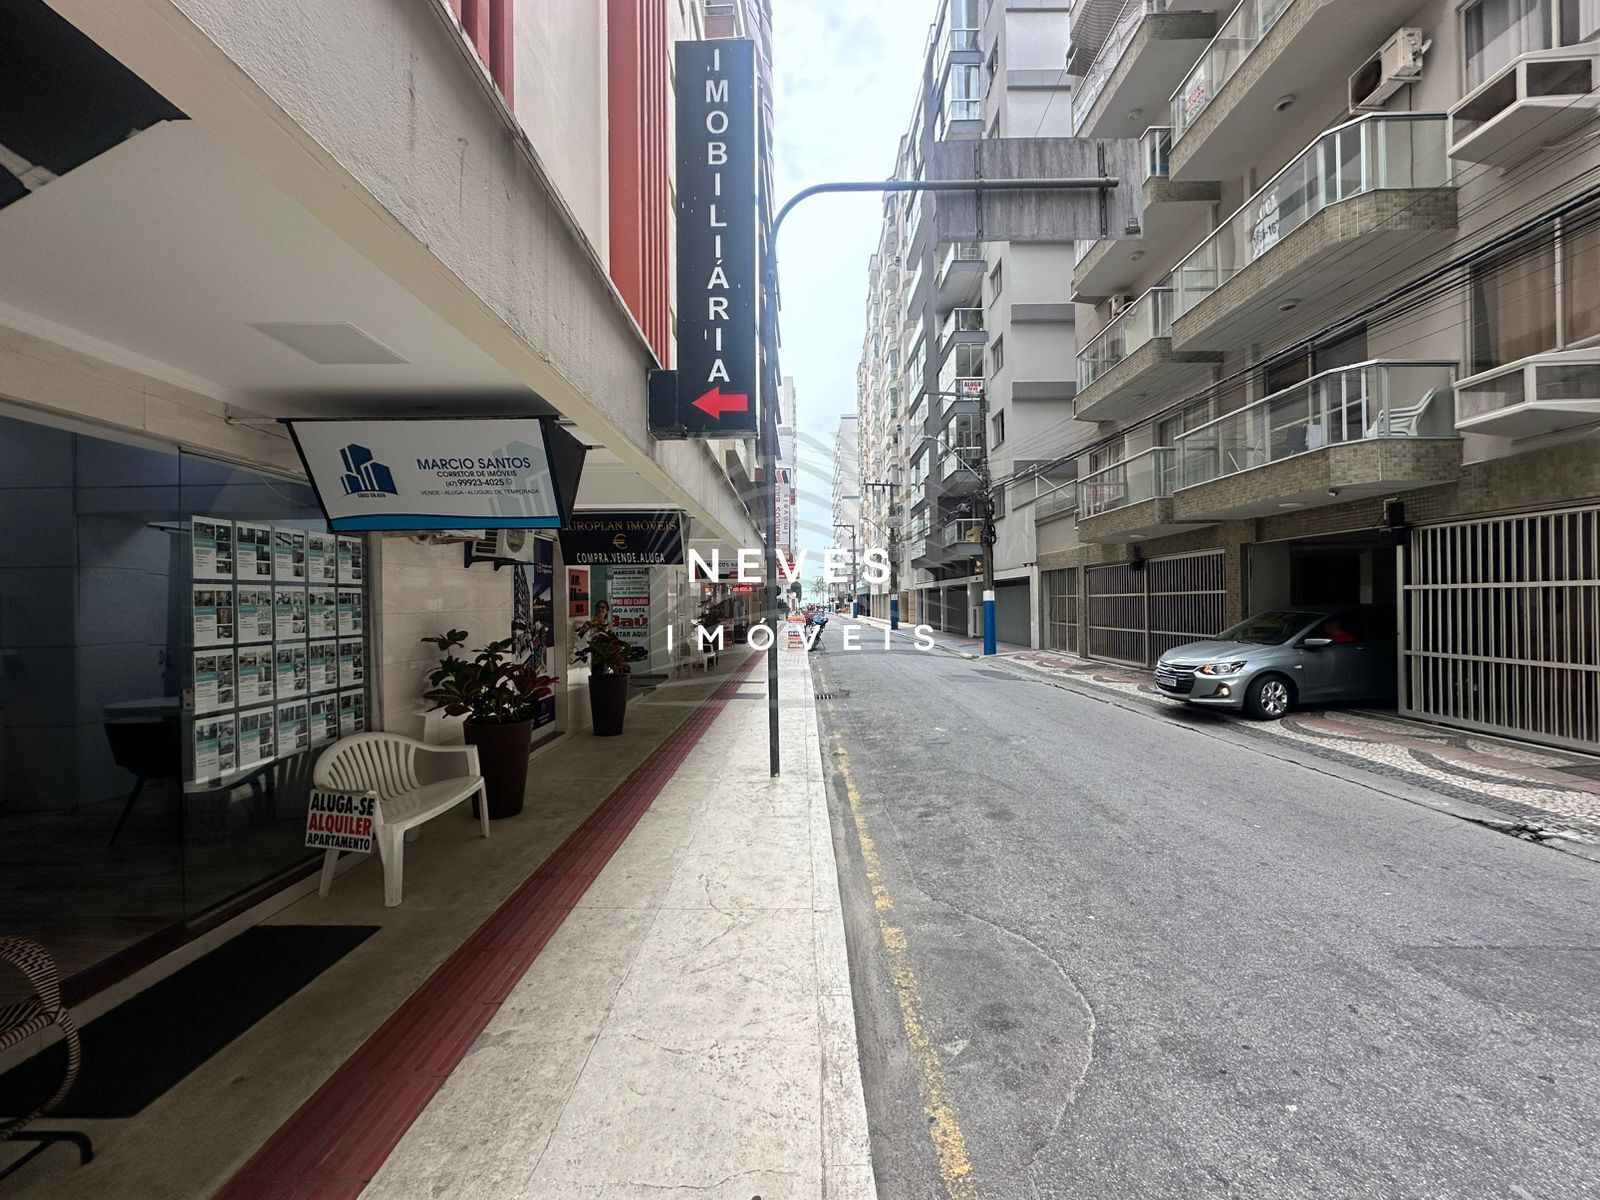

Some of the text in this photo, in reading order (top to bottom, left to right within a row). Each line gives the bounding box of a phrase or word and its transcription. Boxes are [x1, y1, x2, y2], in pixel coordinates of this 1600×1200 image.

[705, 48, 730, 382] IMOBILIÁRIA
[416, 457, 531, 470] MARCIO SANTOS
[487, 469, 517, 477] IMÓVEIS
[458, 479, 505, 487] 99923-4025
[569, 518, 678, 531] UROPLAN IMÓVEIS
[310, 793, 375, 816] ALUGA-SE
[308, 813, 372, 836] ALQUILER
[307, 833, 370, 851] APARTAMENTO
